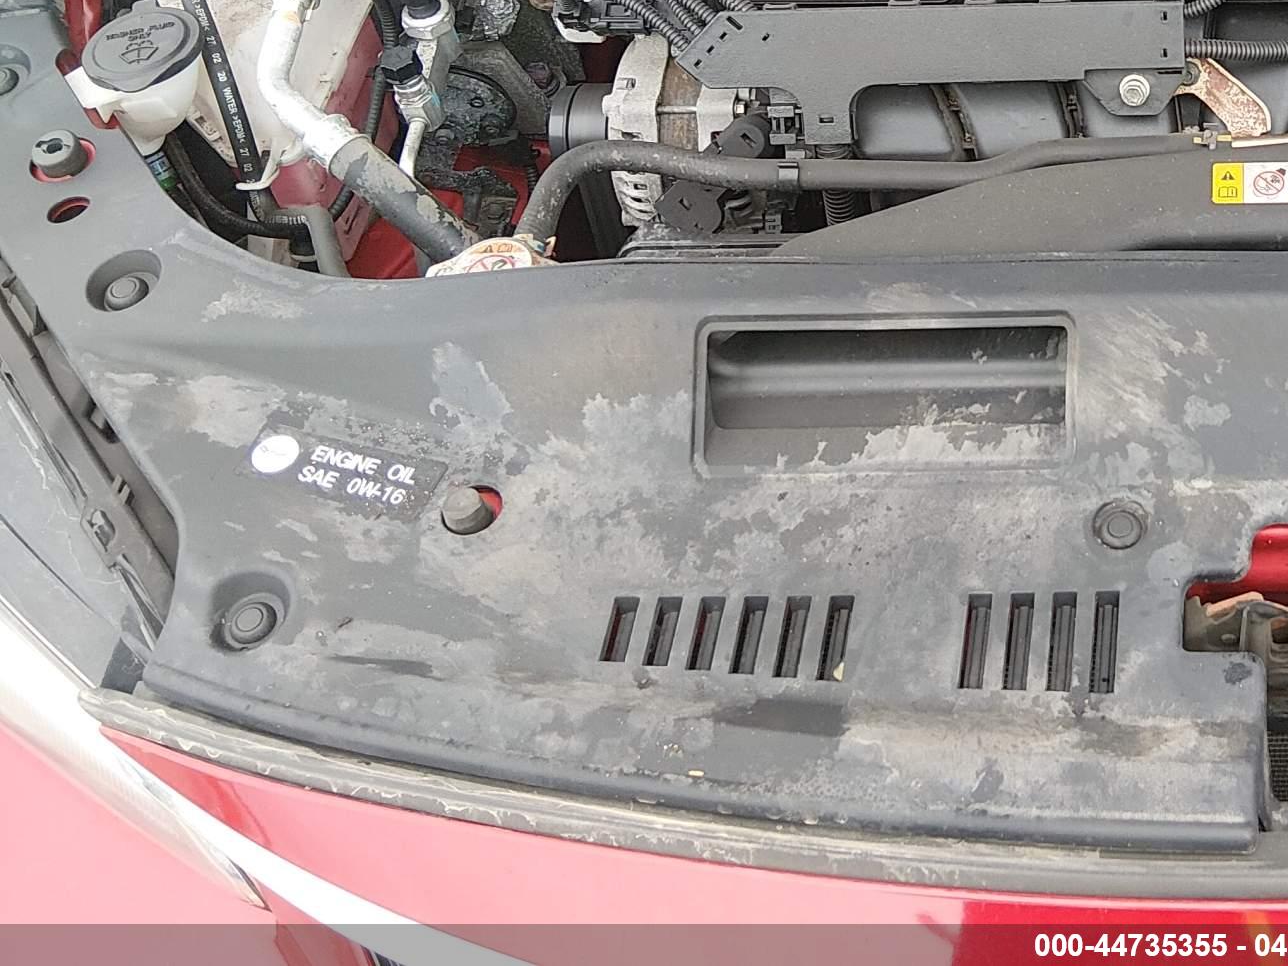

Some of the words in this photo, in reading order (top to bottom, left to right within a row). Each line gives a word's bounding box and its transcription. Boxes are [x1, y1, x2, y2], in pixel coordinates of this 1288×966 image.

[212, 52, 222, 64] 02
[217, 71, 227, 82] 20
[222, 86, 238, 114] WATER
[298, 465, 340, 488] SAE
[346, 477, 406, 505] 0W-16
[310, 445, 381, 474] ENGINE
[387, 464, 416, 485] OIL
